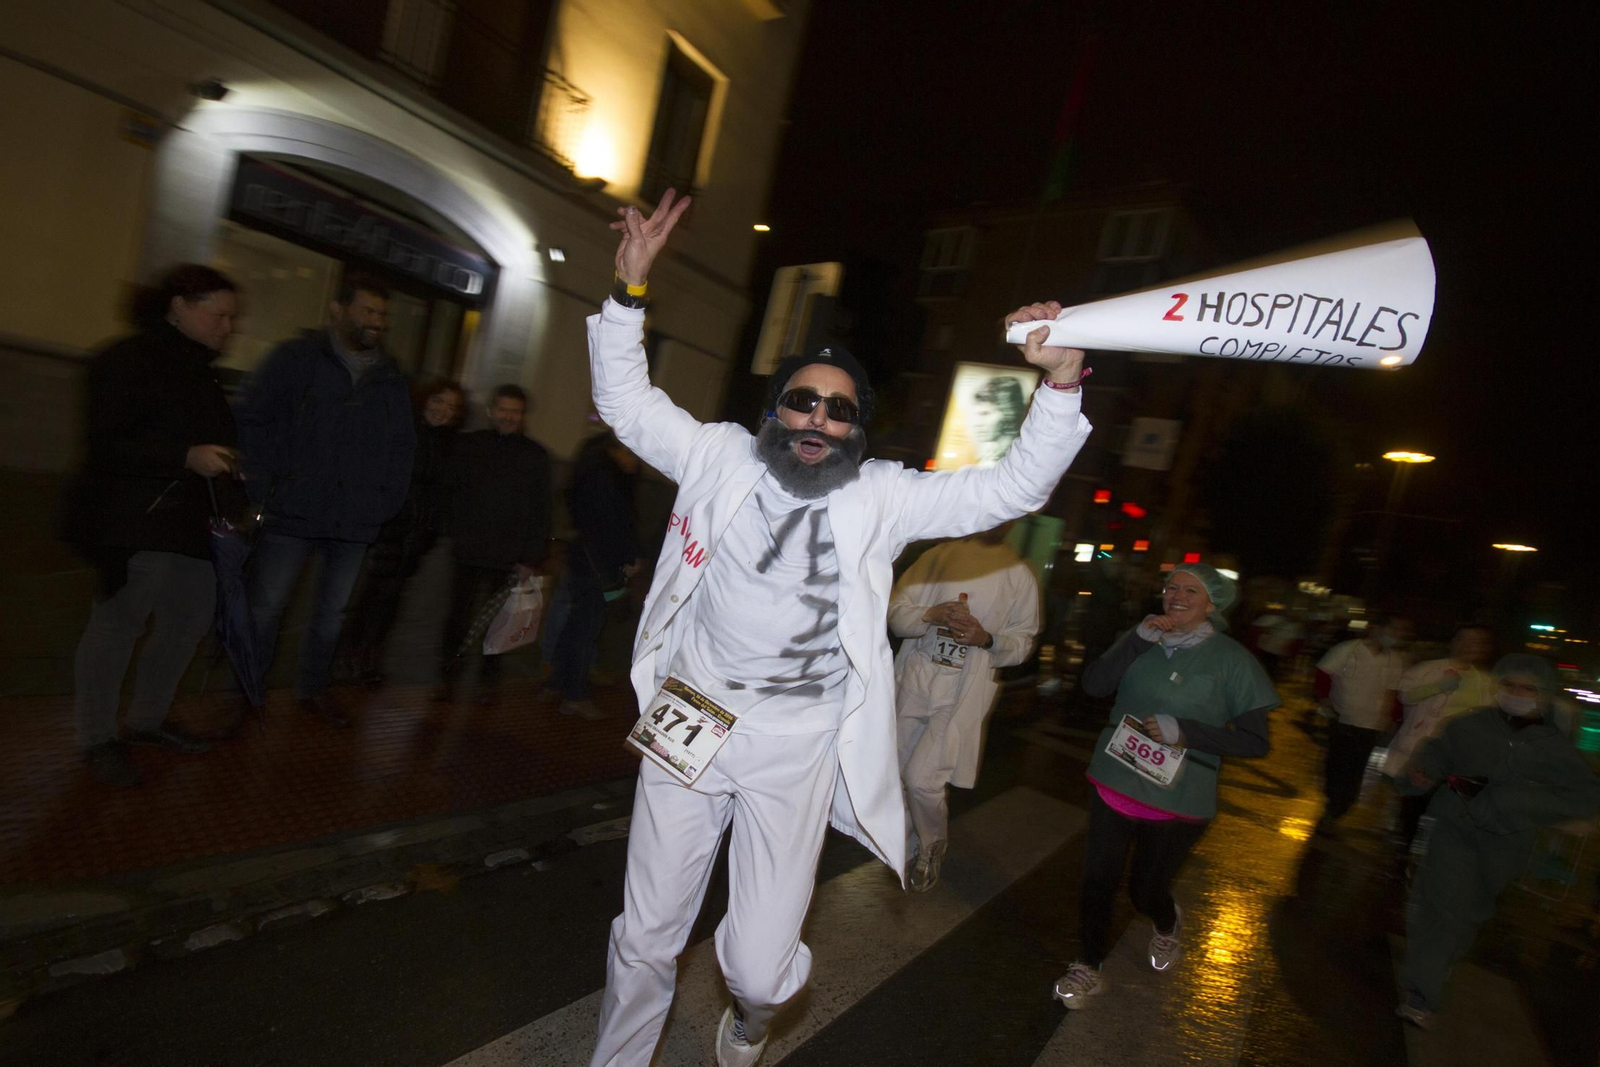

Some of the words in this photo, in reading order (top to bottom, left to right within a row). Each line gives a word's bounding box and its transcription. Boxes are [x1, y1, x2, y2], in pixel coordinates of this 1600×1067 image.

[1162, 293, 1189, 322] 2
[1197, 291, 1420, 351] HOSPITALES
[651, 703, 704, 747] 471
[1125, 734, 1166, 766] 569
